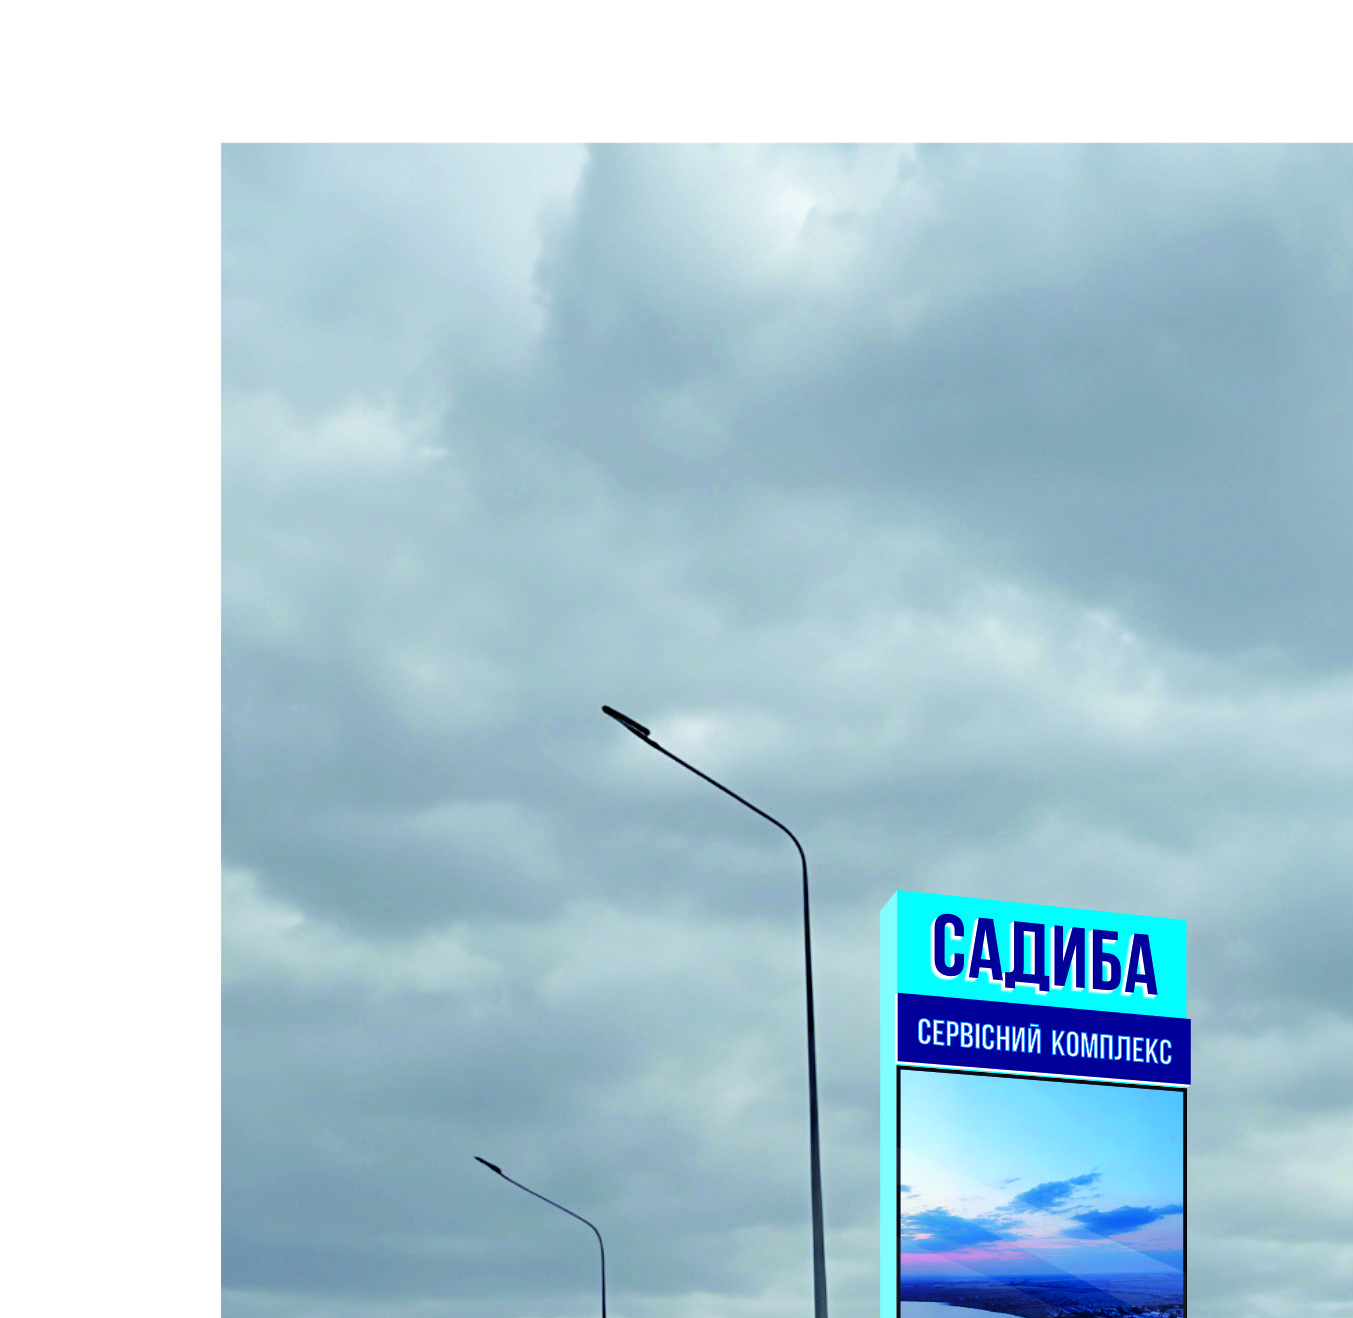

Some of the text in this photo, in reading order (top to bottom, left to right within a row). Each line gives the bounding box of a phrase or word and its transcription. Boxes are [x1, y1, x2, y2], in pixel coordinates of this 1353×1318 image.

[934, 913, 1158, 996] САДИБА
[918, 1018, 1172, 1065] СЕРВІСНИЙ КОМПЛЕКС
